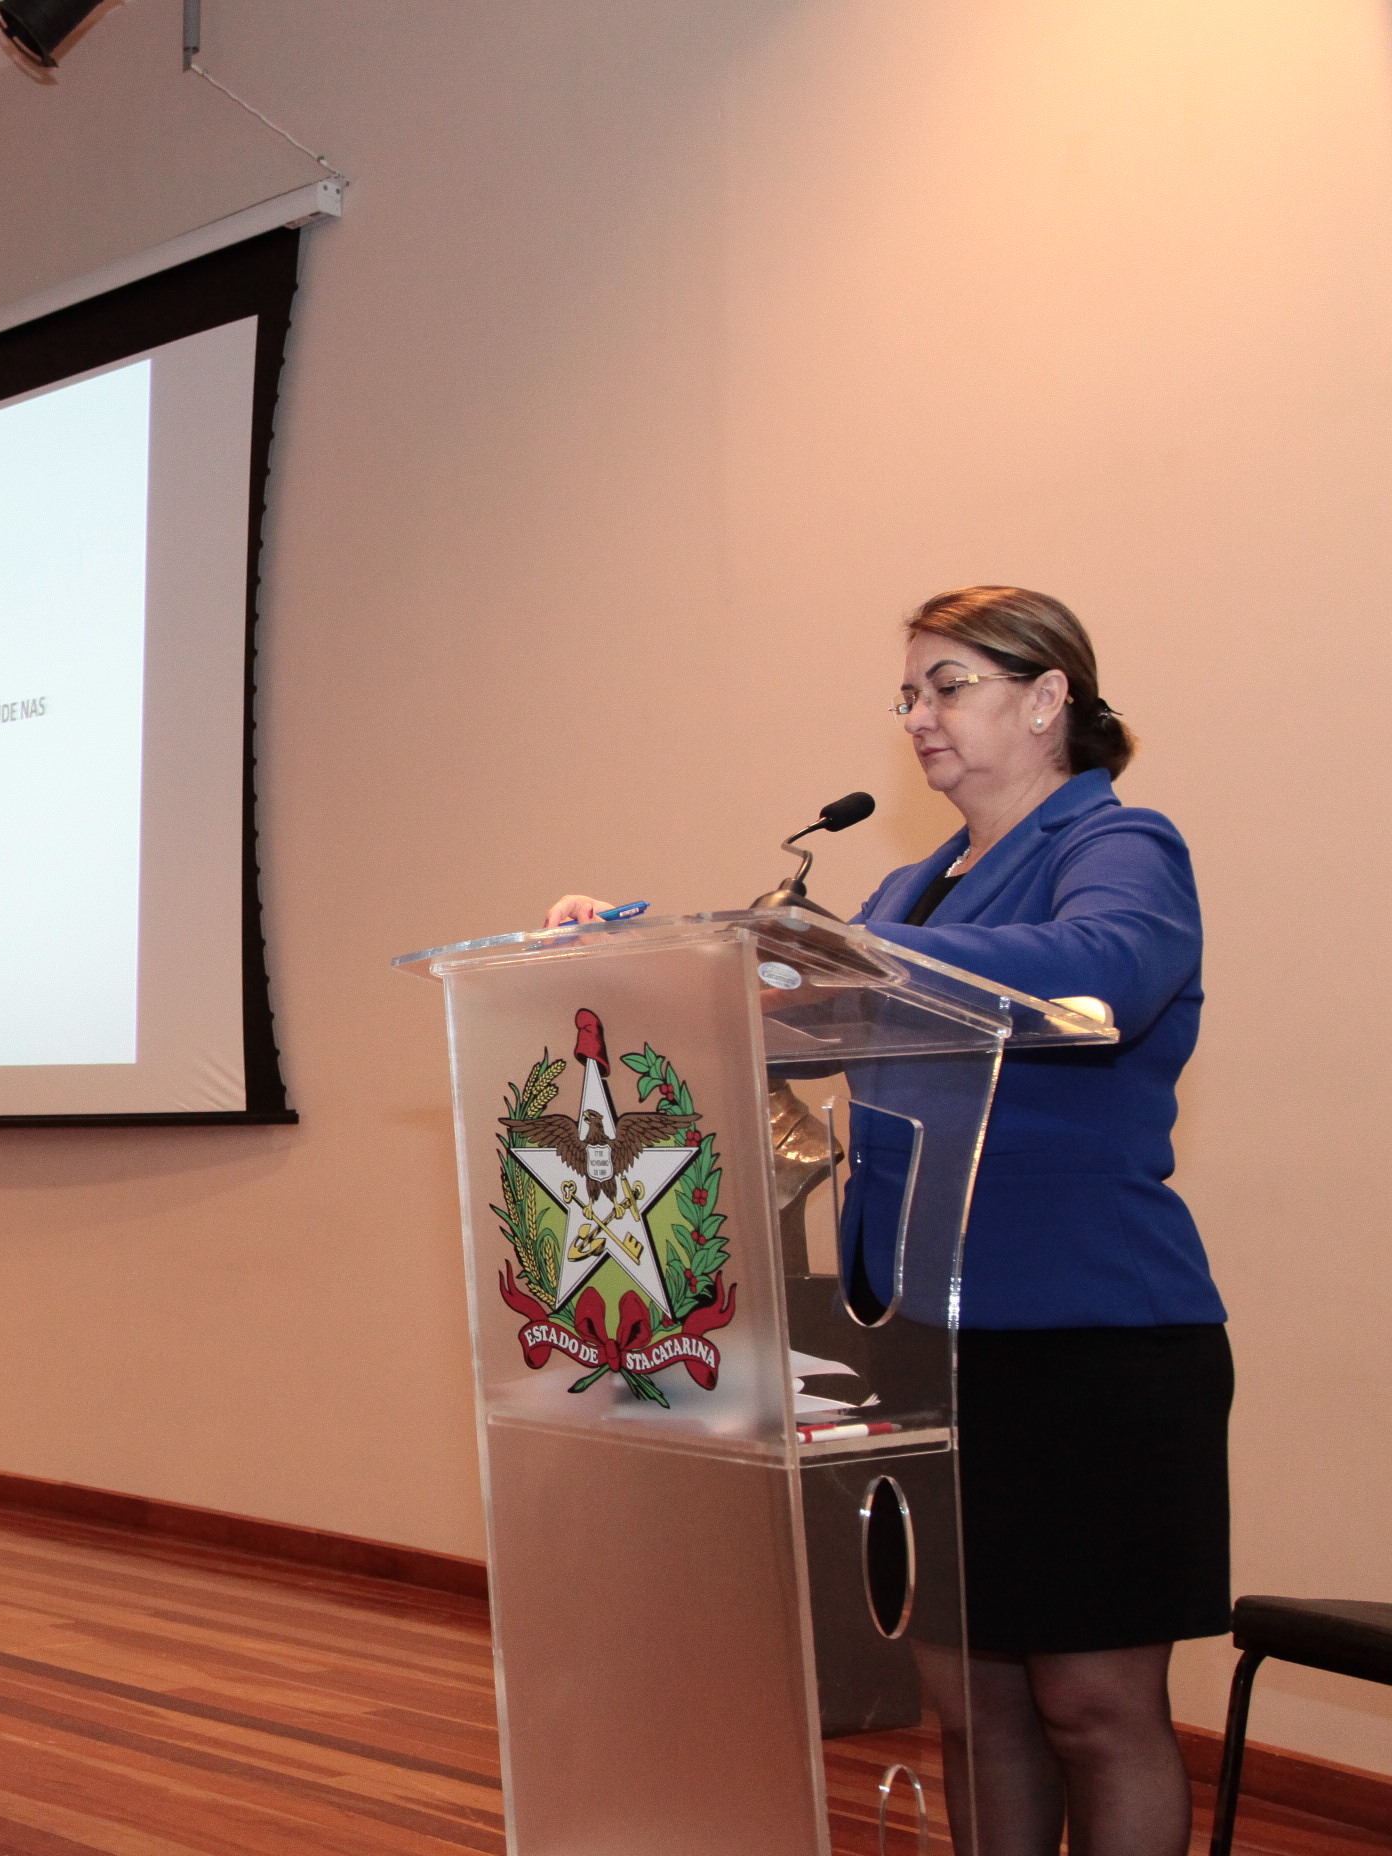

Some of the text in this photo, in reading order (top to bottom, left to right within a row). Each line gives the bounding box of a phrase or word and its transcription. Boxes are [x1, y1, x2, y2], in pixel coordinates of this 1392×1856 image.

[20, 696, 46, 720] NAS
[524, 1325, 599, 1364] ESTADO DE
